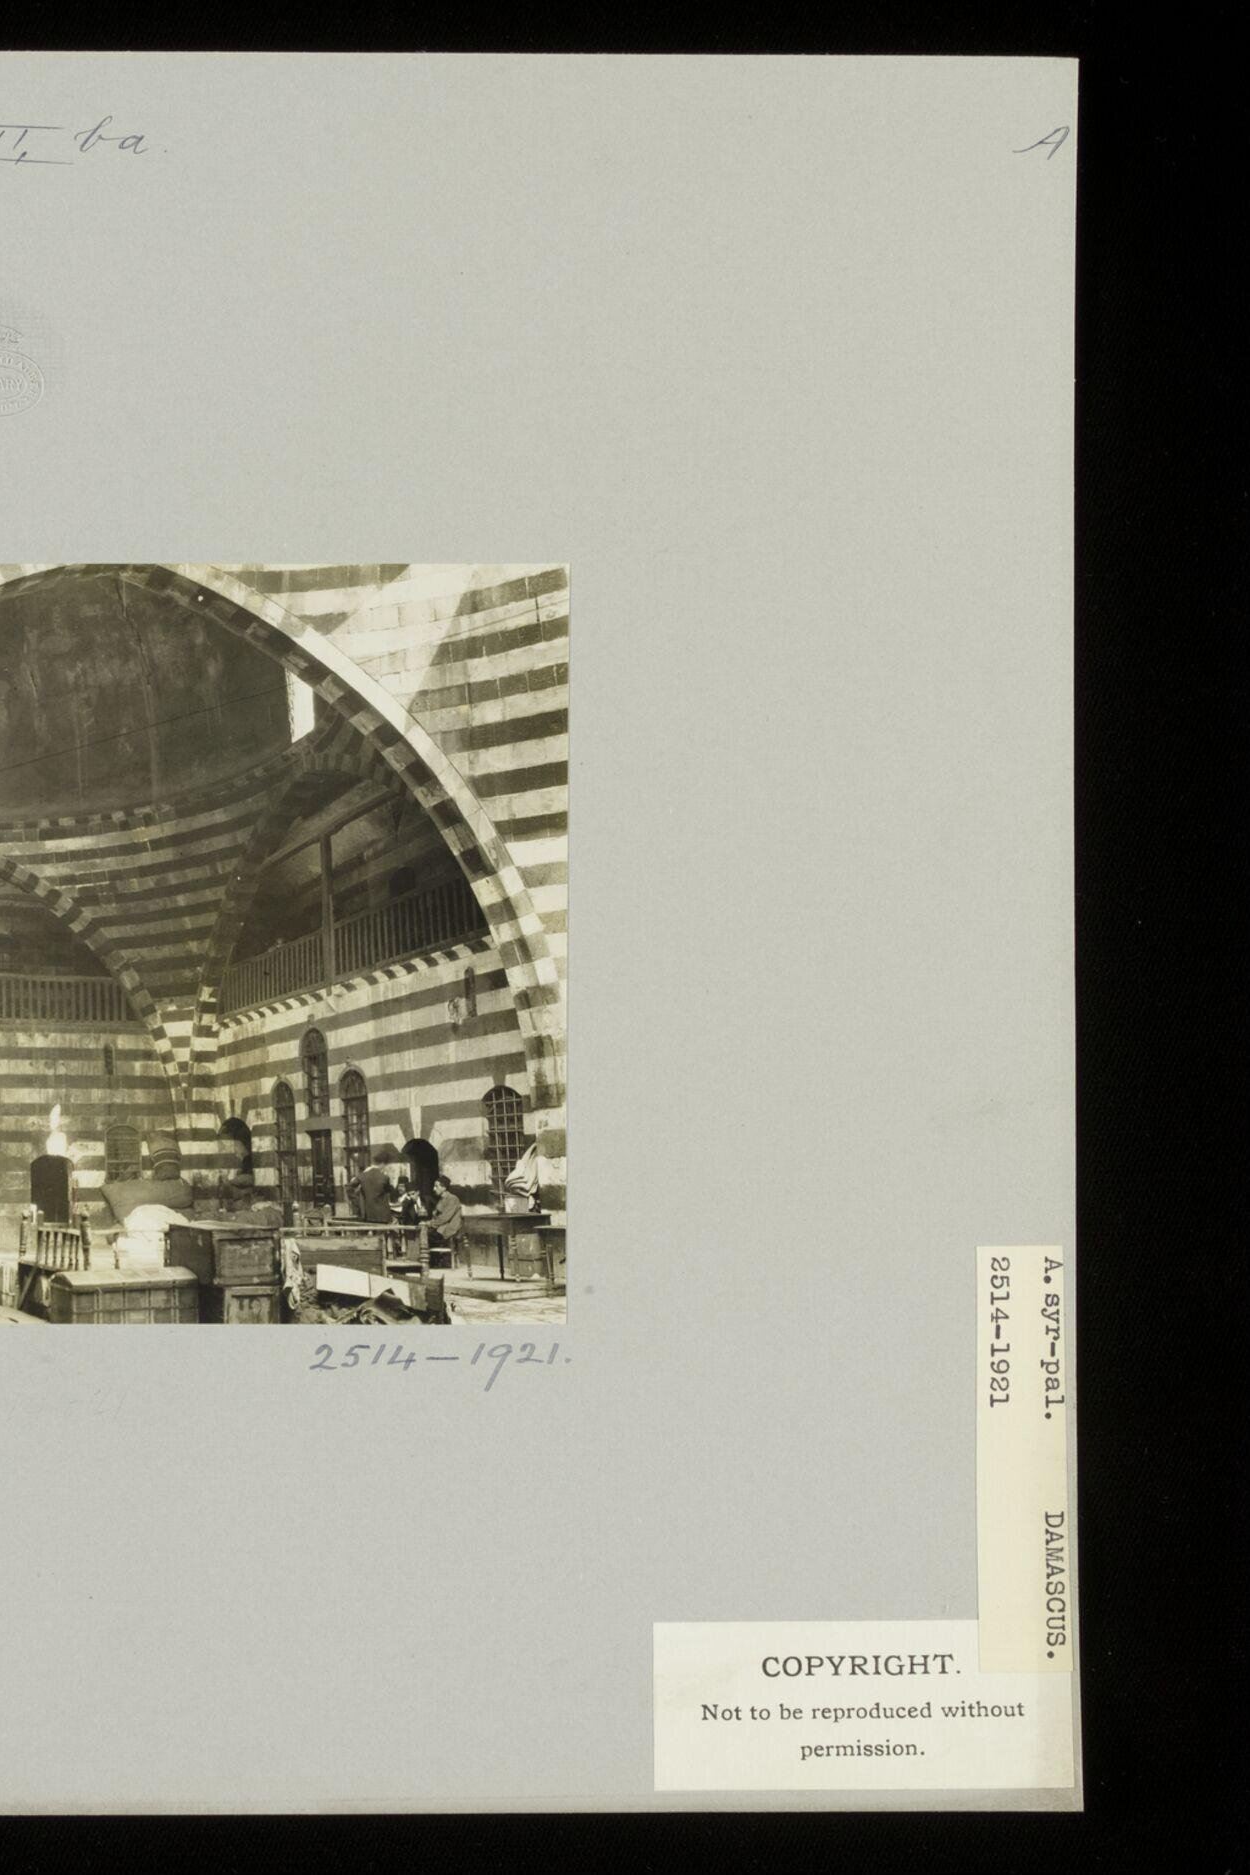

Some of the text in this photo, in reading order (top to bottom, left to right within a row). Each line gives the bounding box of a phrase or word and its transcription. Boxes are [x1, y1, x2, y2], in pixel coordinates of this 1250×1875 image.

[1012, 126, 1070, 160] A
[989, 1256, 1011, 1408] 2514-1921
[1040, 1256, 1067, 1659] A. syr-pal. DAMASCUS.
[761, 1653, 962, 1678] COPYRIGHT.
[700, 1699, 1026, 1724] Not to be reproduced without
[799, 1738, 926, 1761] permission.
